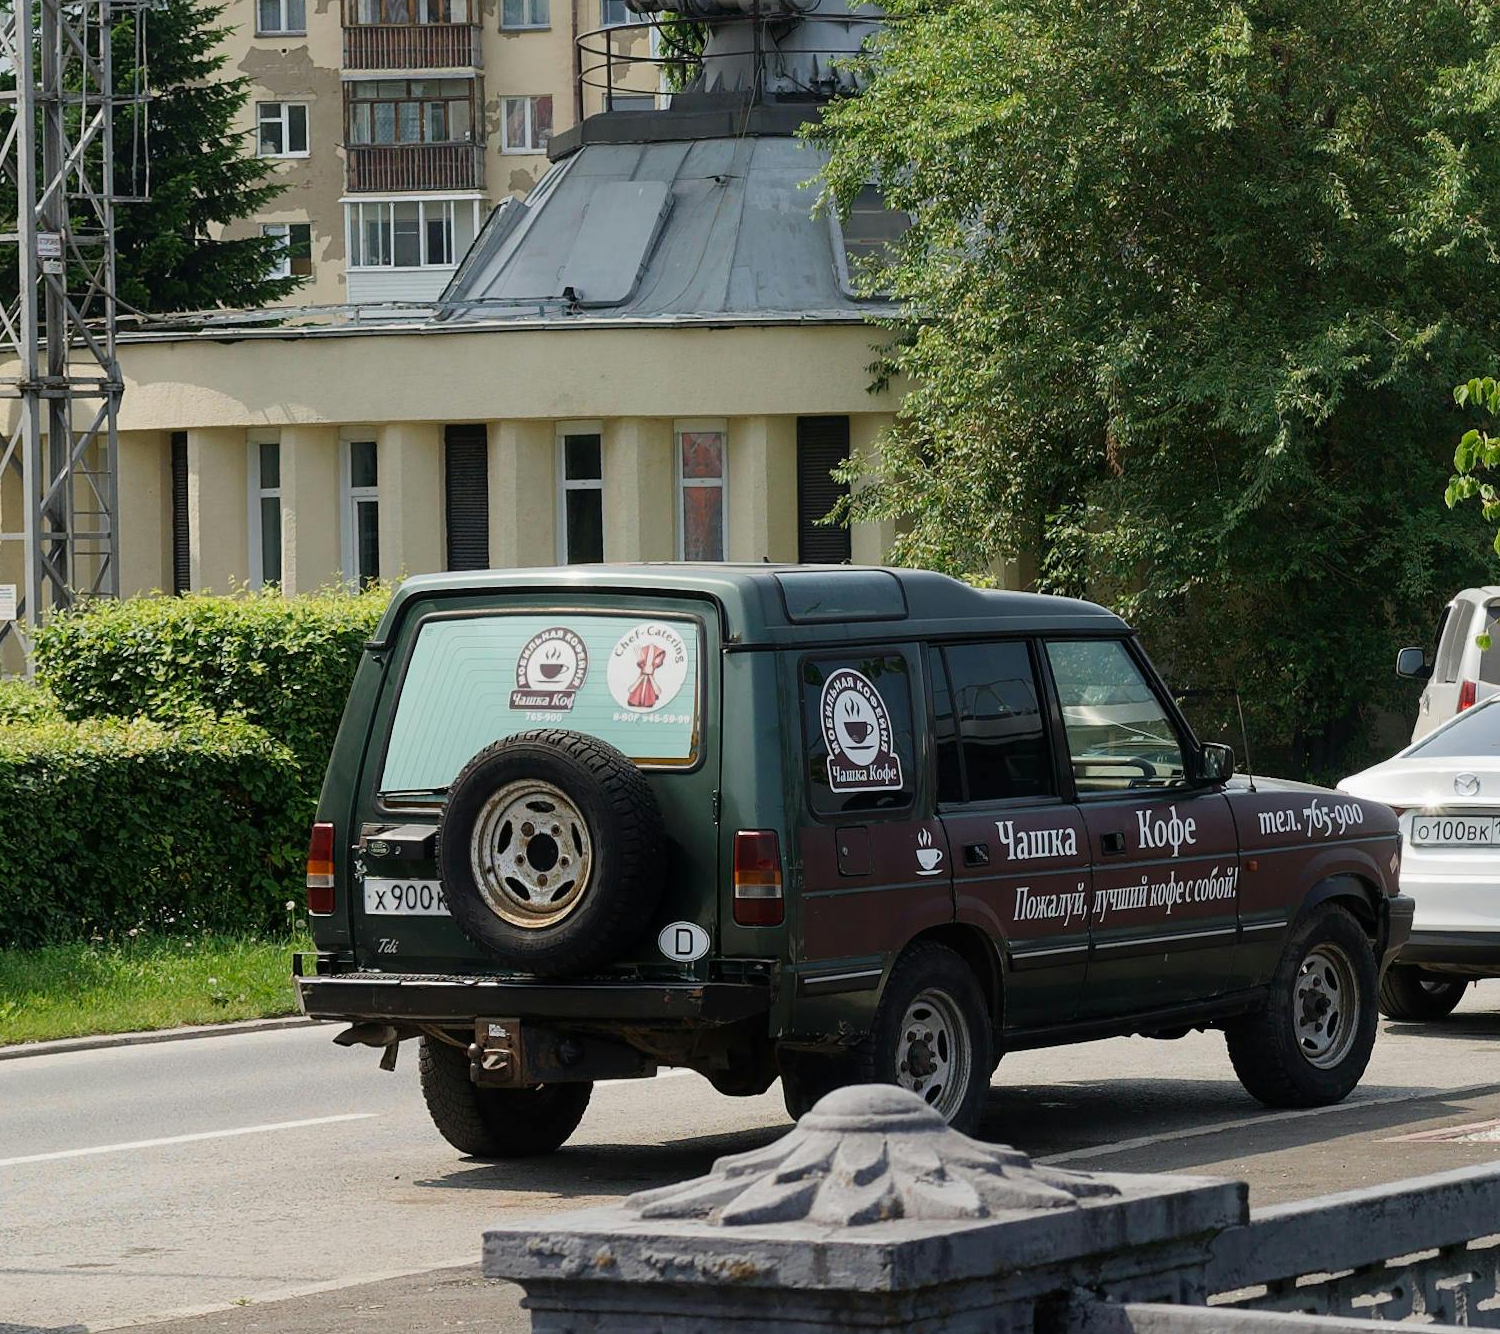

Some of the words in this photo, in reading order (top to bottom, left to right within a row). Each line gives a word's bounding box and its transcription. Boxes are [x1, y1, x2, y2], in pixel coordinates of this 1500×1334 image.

[512, 693, 550, 706] Чашка
[825, 676, 854, 755] МОБИЛЬНАЯ
[856, 680, 888, 753] КОФЕЙНЯ
[831, 765, 868, 783] Чашка
[869, 763, 897, 785] Кофе
[994, 820, 1078, 861] Чашка
[1135, 805, 1197, 858] Кофе
[1258, 808, 1302, 835] тел.
[1302, 798, 1364, 838] 765-900
[1012, 882, 1088, 927] Пожалуй,
[1091, 875, 1149, 923] лучший
[1149, 870, 1185, 915] кофе
[1185, 880, 1193, 903] с
[1194, 865, 1239, 903] собой!
[675, 928, 694, 955] D
